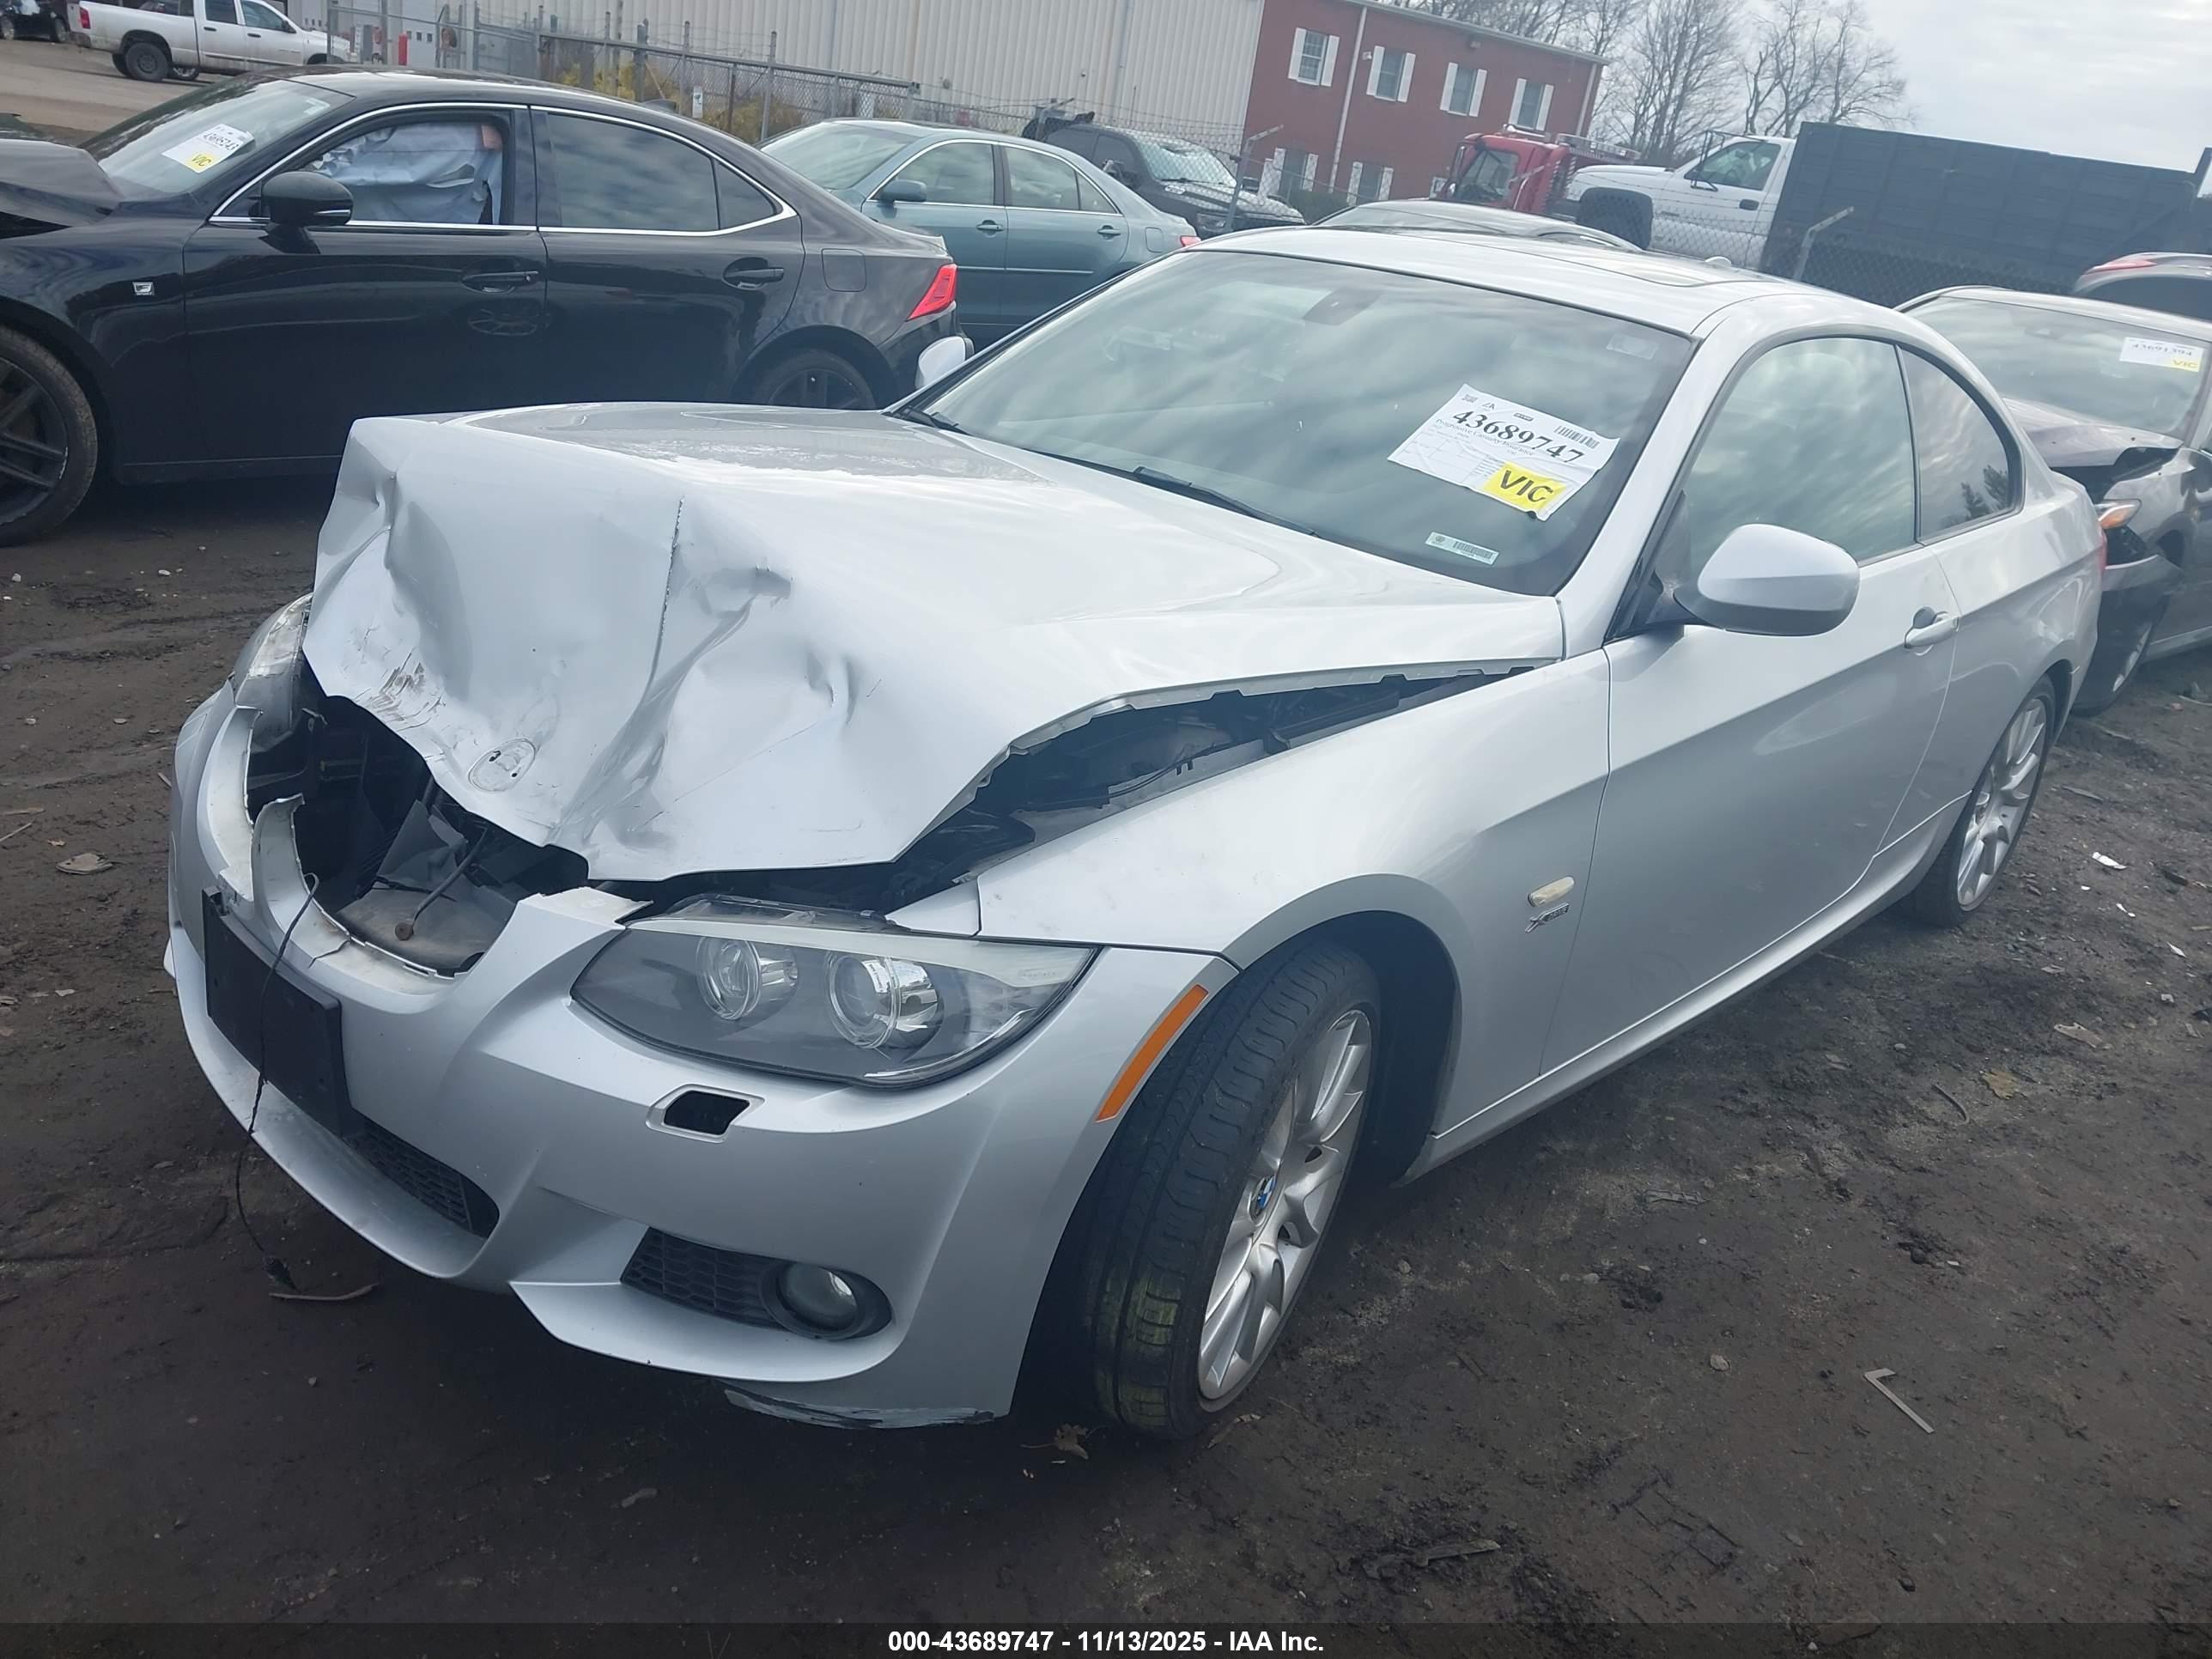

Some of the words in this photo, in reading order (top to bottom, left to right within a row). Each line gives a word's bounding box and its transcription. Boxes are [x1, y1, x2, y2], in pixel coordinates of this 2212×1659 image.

[191, 154, 212, 167] VIC
[2173, 359, 2198, 368] VIC
[1453, 410, 1584, 463] 43689747
[1500, 470, 1553, 502] VIC
